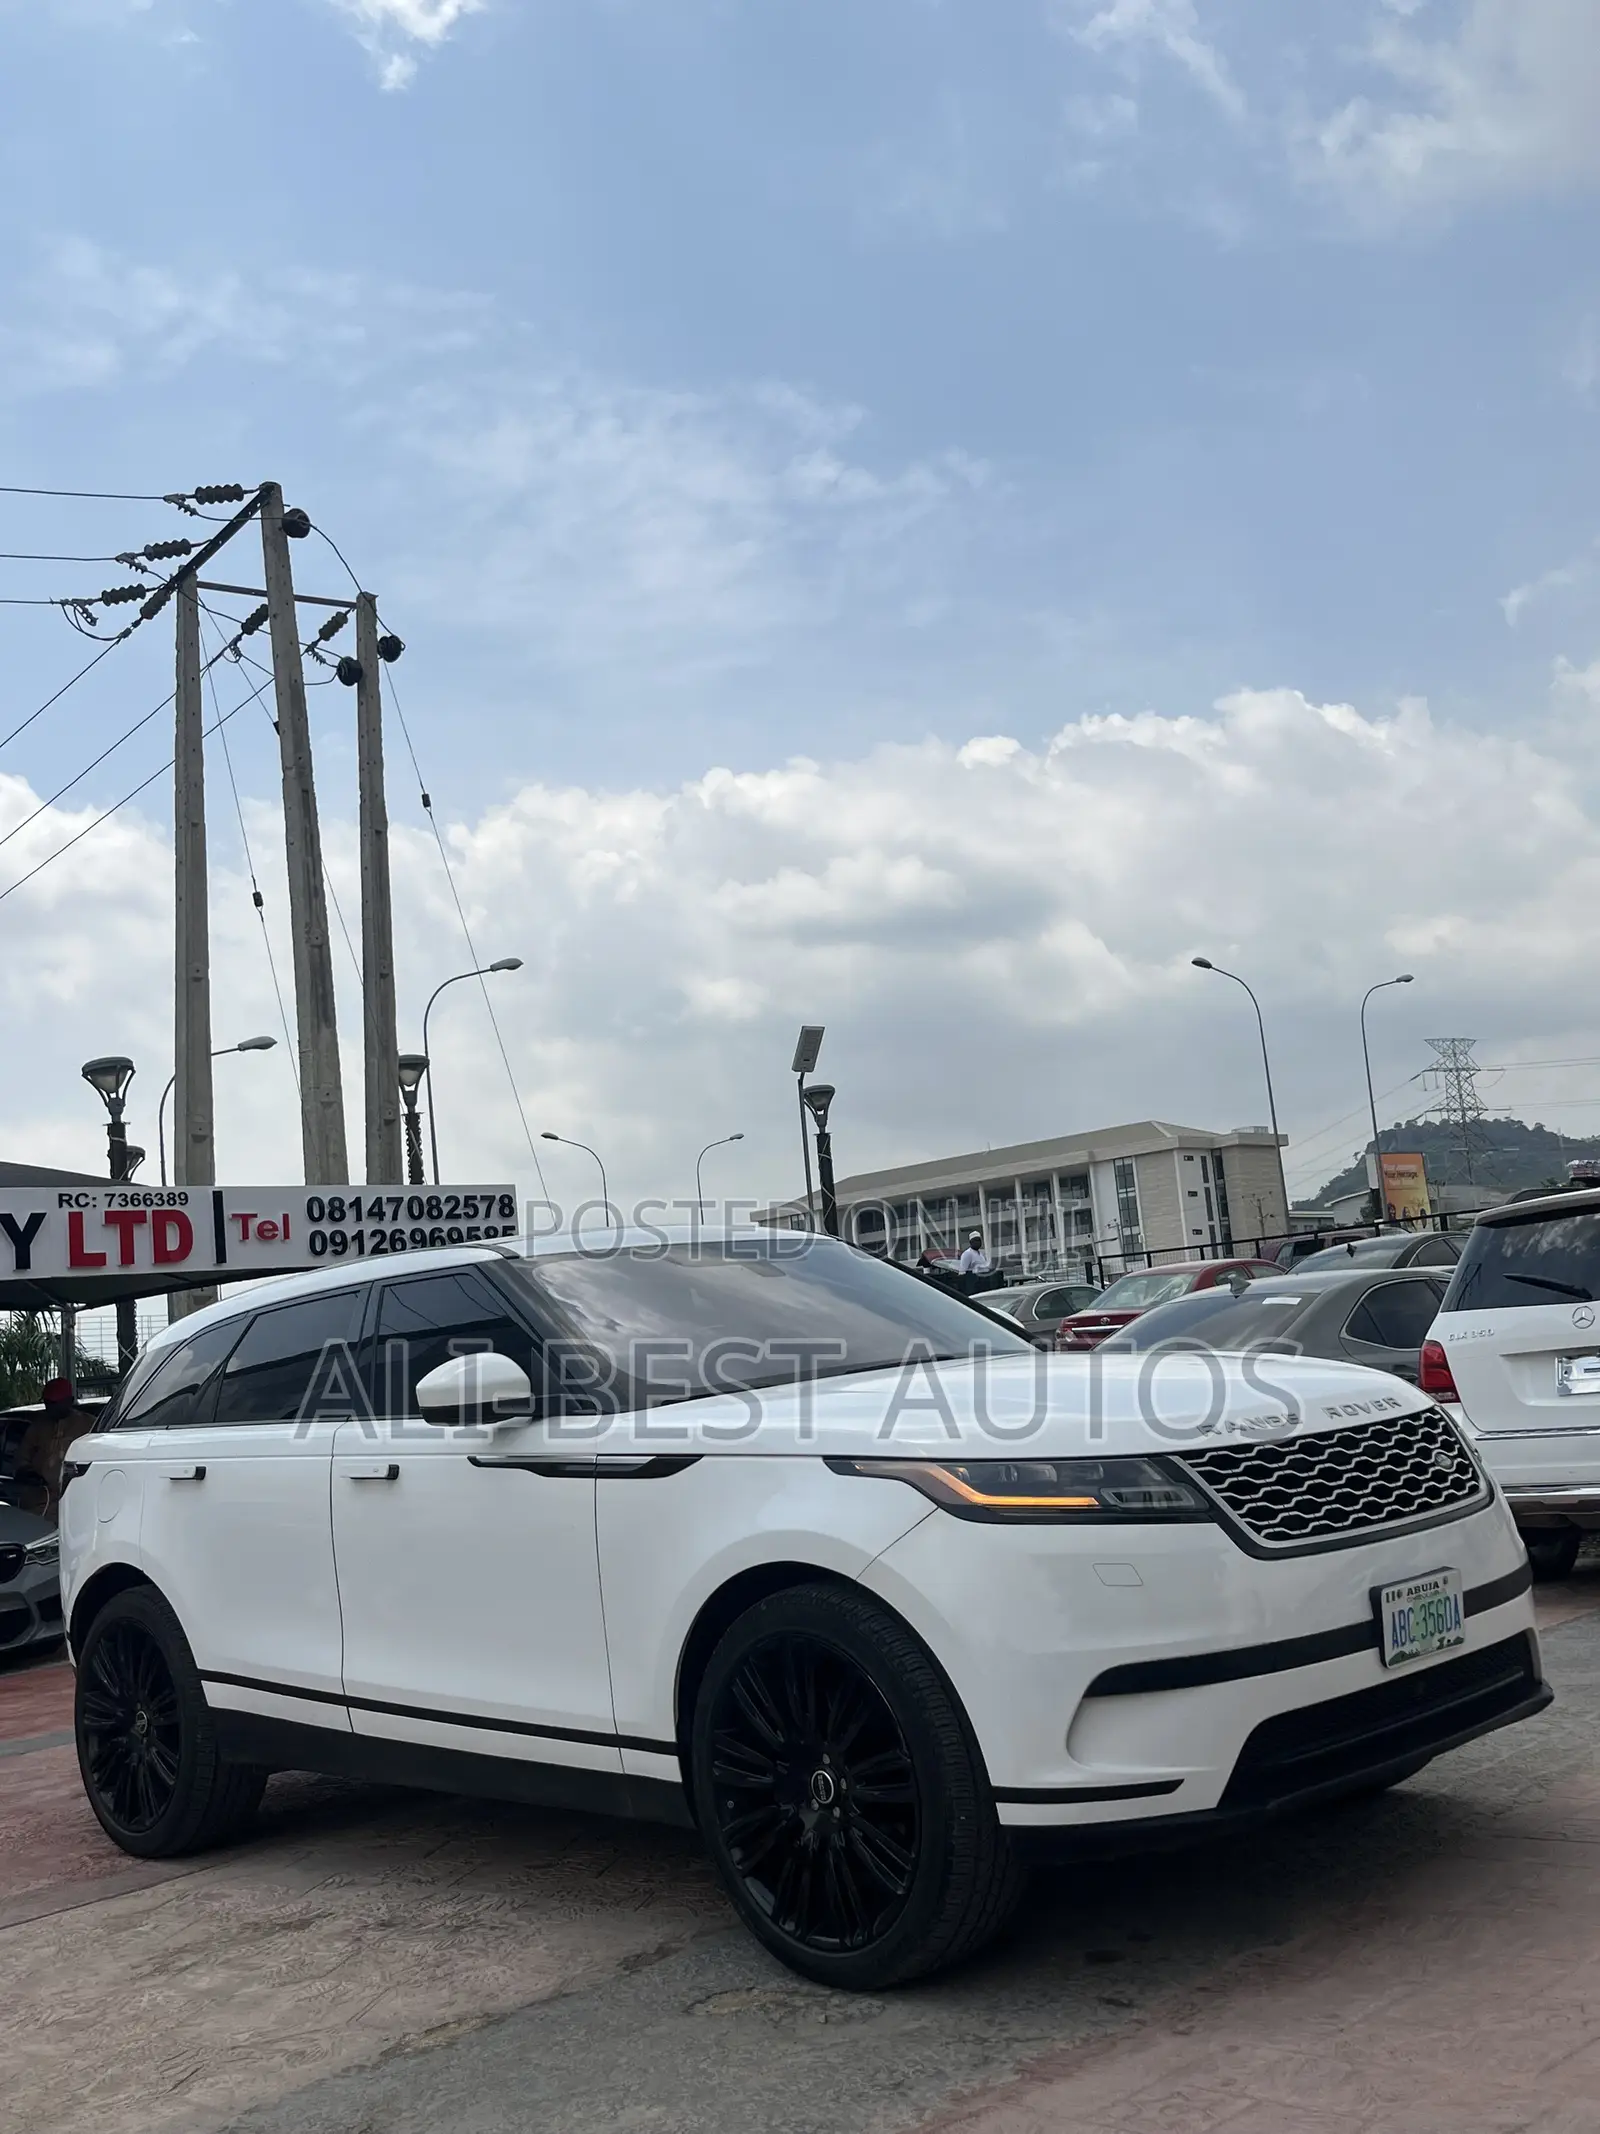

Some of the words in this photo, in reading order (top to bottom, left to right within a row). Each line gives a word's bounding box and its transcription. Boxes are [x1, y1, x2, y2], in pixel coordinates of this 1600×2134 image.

[58, 1192, 97, 1208] RC:
[104, 1192, 189, 1207] 7366389
[306, 1194, 515, 1222] 08147082578
[67, 1209, 194, 1268] LTD
[230, 1213, 290, 1240] Tel
[1325, 1396, 1402, 1419] ROVER
